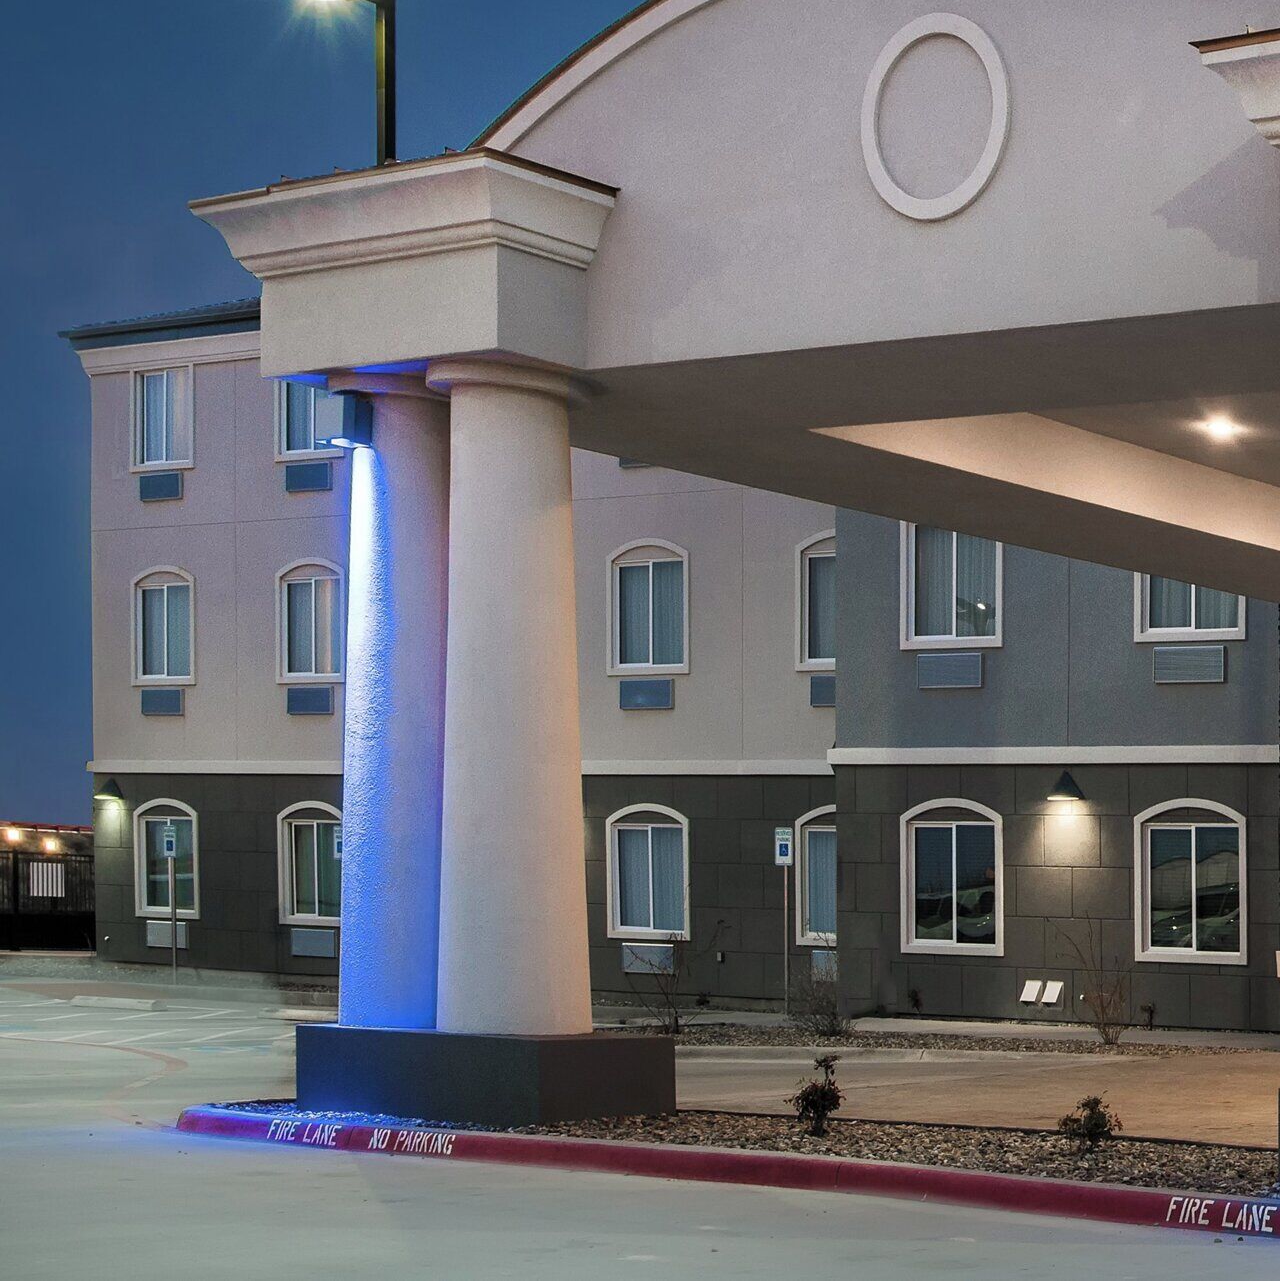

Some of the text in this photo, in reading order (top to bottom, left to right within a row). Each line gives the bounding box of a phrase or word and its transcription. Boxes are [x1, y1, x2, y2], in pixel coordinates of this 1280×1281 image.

[266, 1119, 456, 1155] FIRE LANE NO PARKING
[1165, 1196, 1215, 1225] FIRE
[1221, 1202, 1278, 1233] LANE
